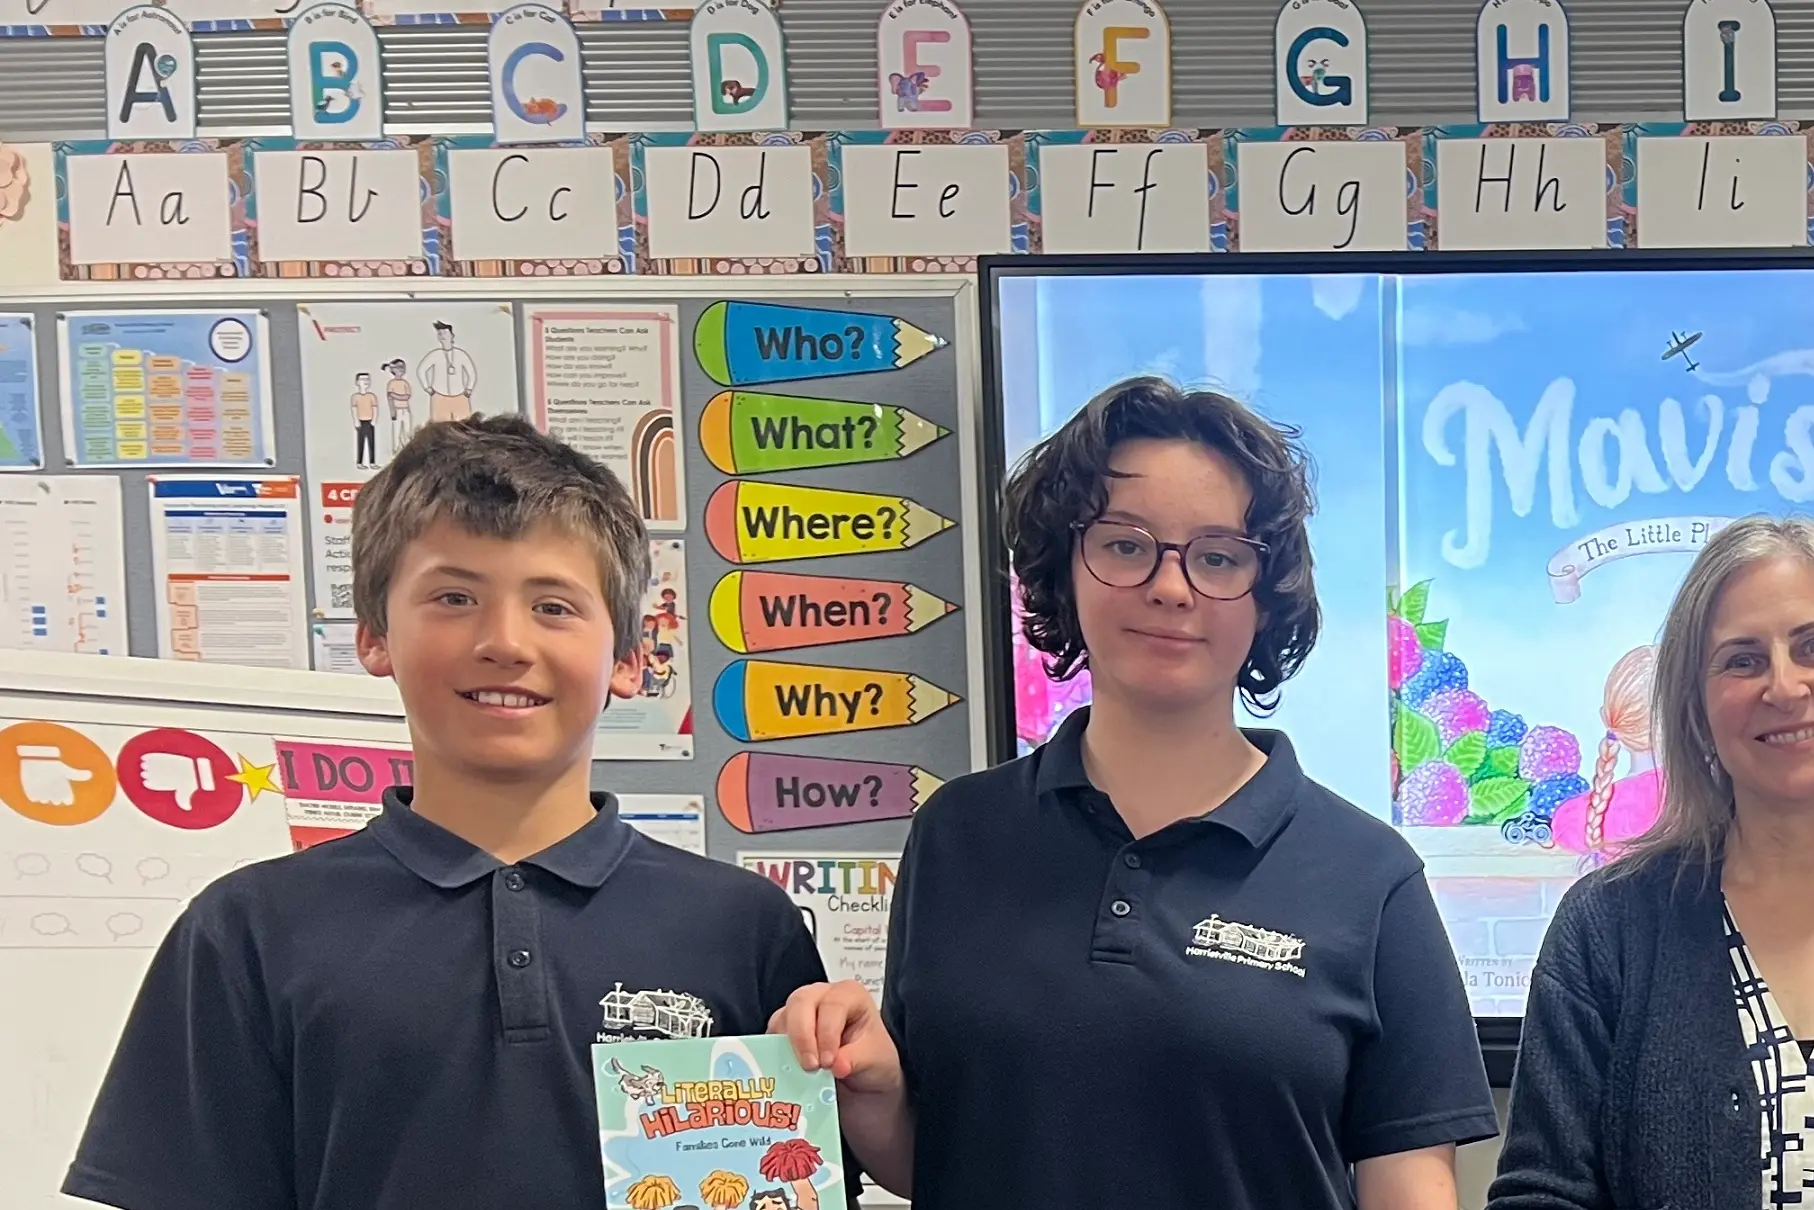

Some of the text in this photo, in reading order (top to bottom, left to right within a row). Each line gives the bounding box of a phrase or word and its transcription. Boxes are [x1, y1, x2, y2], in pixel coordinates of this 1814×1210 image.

[707, 32, 769, 114] D
[904, 30, 951, 111] E
[1105, 27, 1150, 108] F
[1286, 27, 1351, 107] G
[1498, 24, 1549, 103] H
[1717, 20, 1741, 101] I
[120, 42, 177, 123] A
[313, 41, 360, 123] B
[502, 42, 565, 124] C
[754, 327, 865, 360] Who?
[751, 416, 878, 451] What?
[742, 506, 896, 540] Where?
[1579, 534, 1619, 561] The
[1626, 524, 1681, 547] Little
[760, 593, 892, 628] When?
[775, 683, 883, 724] Why?
[312, 752, 374, 792] DO
[776, 776, 883, 809] How?
[757, 861, 898, 894] WRITIN
[828, 894, 888, 912] Checkli
[843, 923, 881, 936] Capital
[1237, 955, 1275, 971] Primary
[1275, 962, 1306, 978] School
[676, 1136, 772, 1151] Families Gone Wild
